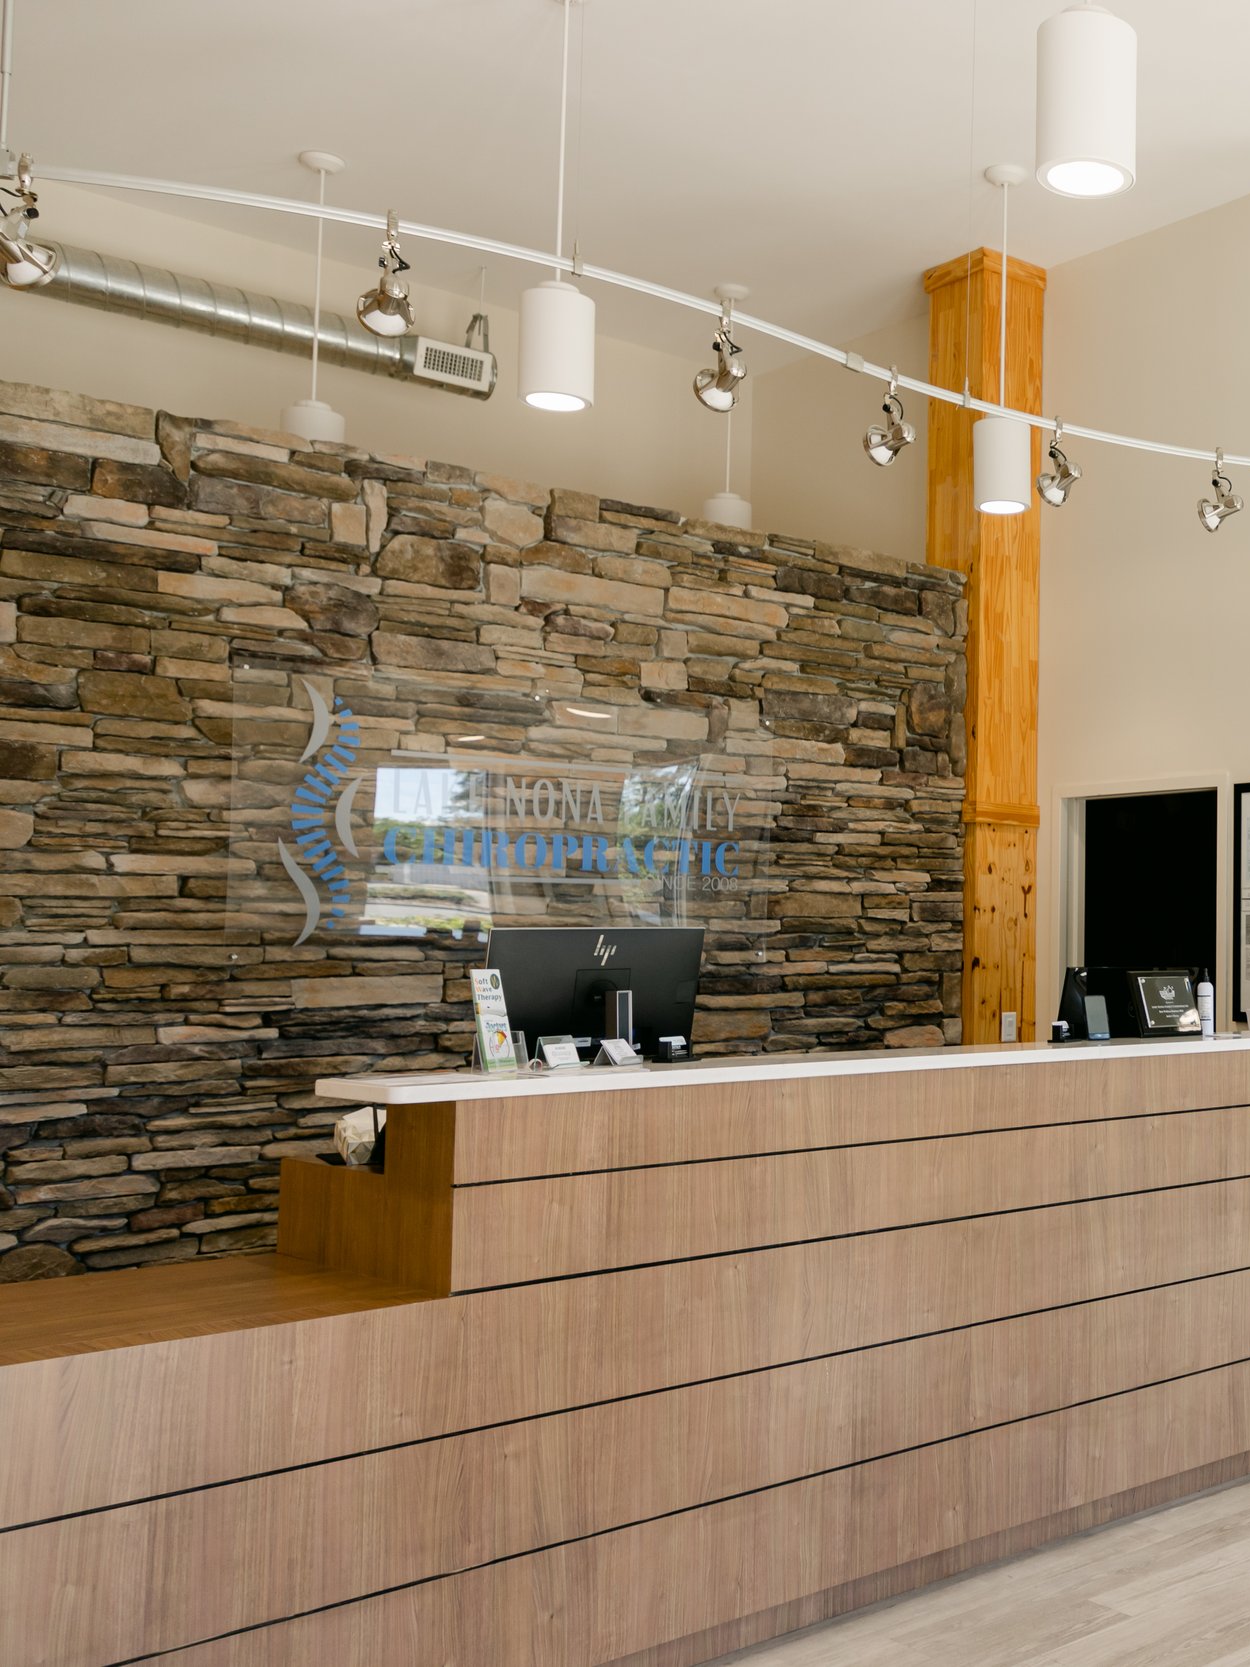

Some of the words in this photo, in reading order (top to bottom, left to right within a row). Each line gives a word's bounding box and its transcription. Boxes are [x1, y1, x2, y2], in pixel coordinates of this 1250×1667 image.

[506, 776, 603, 825] NONA
[383, 826, 739, 877] CHIROPRACTIC
[646, 874, 697, 891] NCE
[702, 876, 738, 892] 2008
[475, 977, 488, 985] Soft
[477, 994, 502, 1002] Therapy
